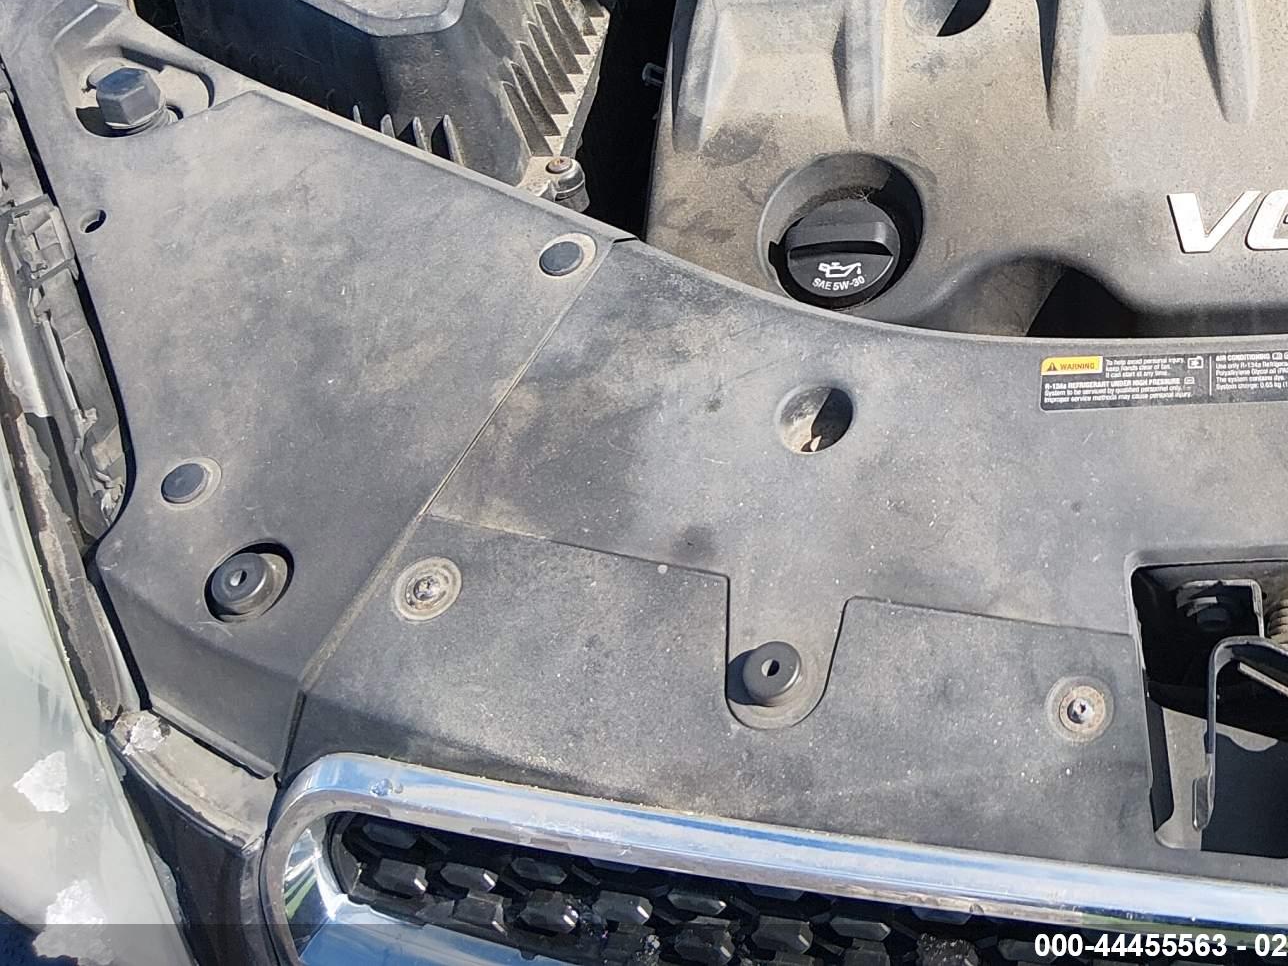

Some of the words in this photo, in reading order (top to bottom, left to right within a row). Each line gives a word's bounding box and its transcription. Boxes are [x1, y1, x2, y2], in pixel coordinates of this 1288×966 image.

[812, 277, 832, 290] SAE
[832, 275, 865, 291] 5W-30
[1059, 361, 1095, 371] WARNING
